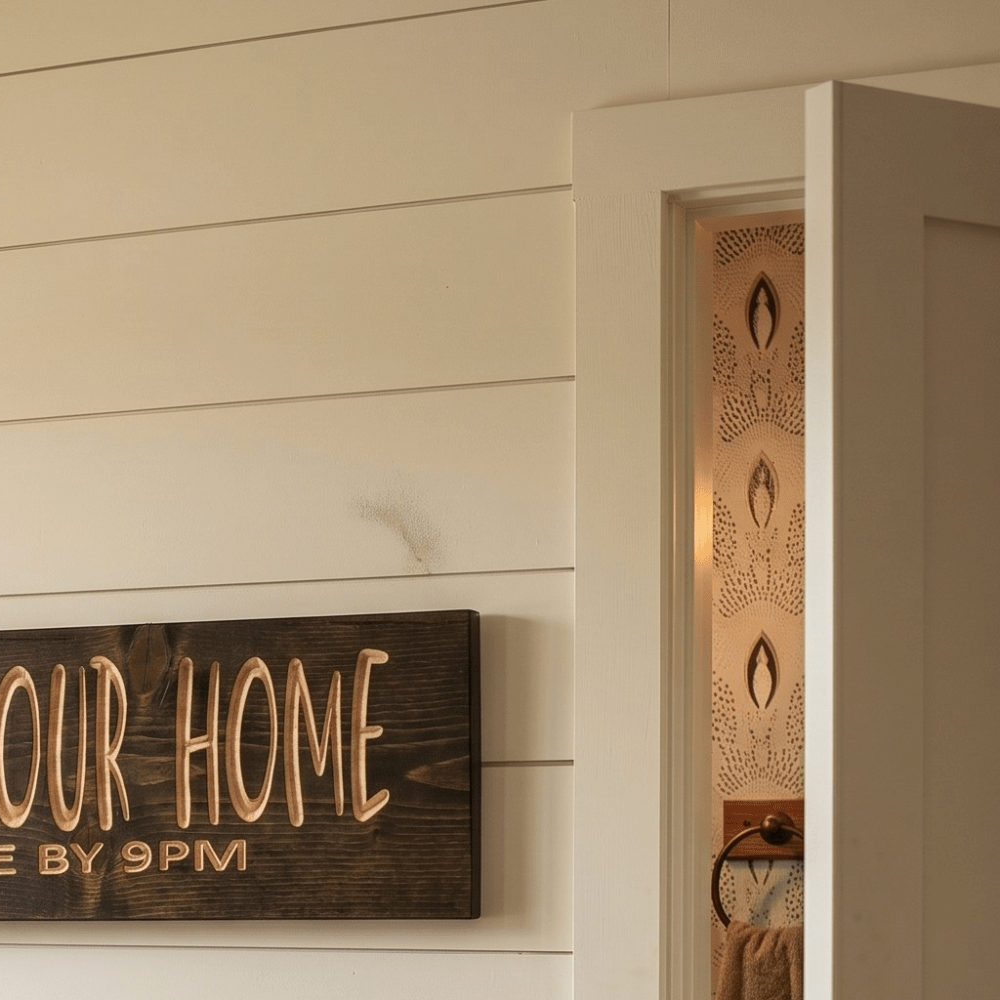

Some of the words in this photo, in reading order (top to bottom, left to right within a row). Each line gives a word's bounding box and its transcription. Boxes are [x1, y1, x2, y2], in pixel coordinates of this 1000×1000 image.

[175, 648, 390, 828] HOME
[38, 842, 104, 876] BY
[121, 839, 247, 874] 9PM
